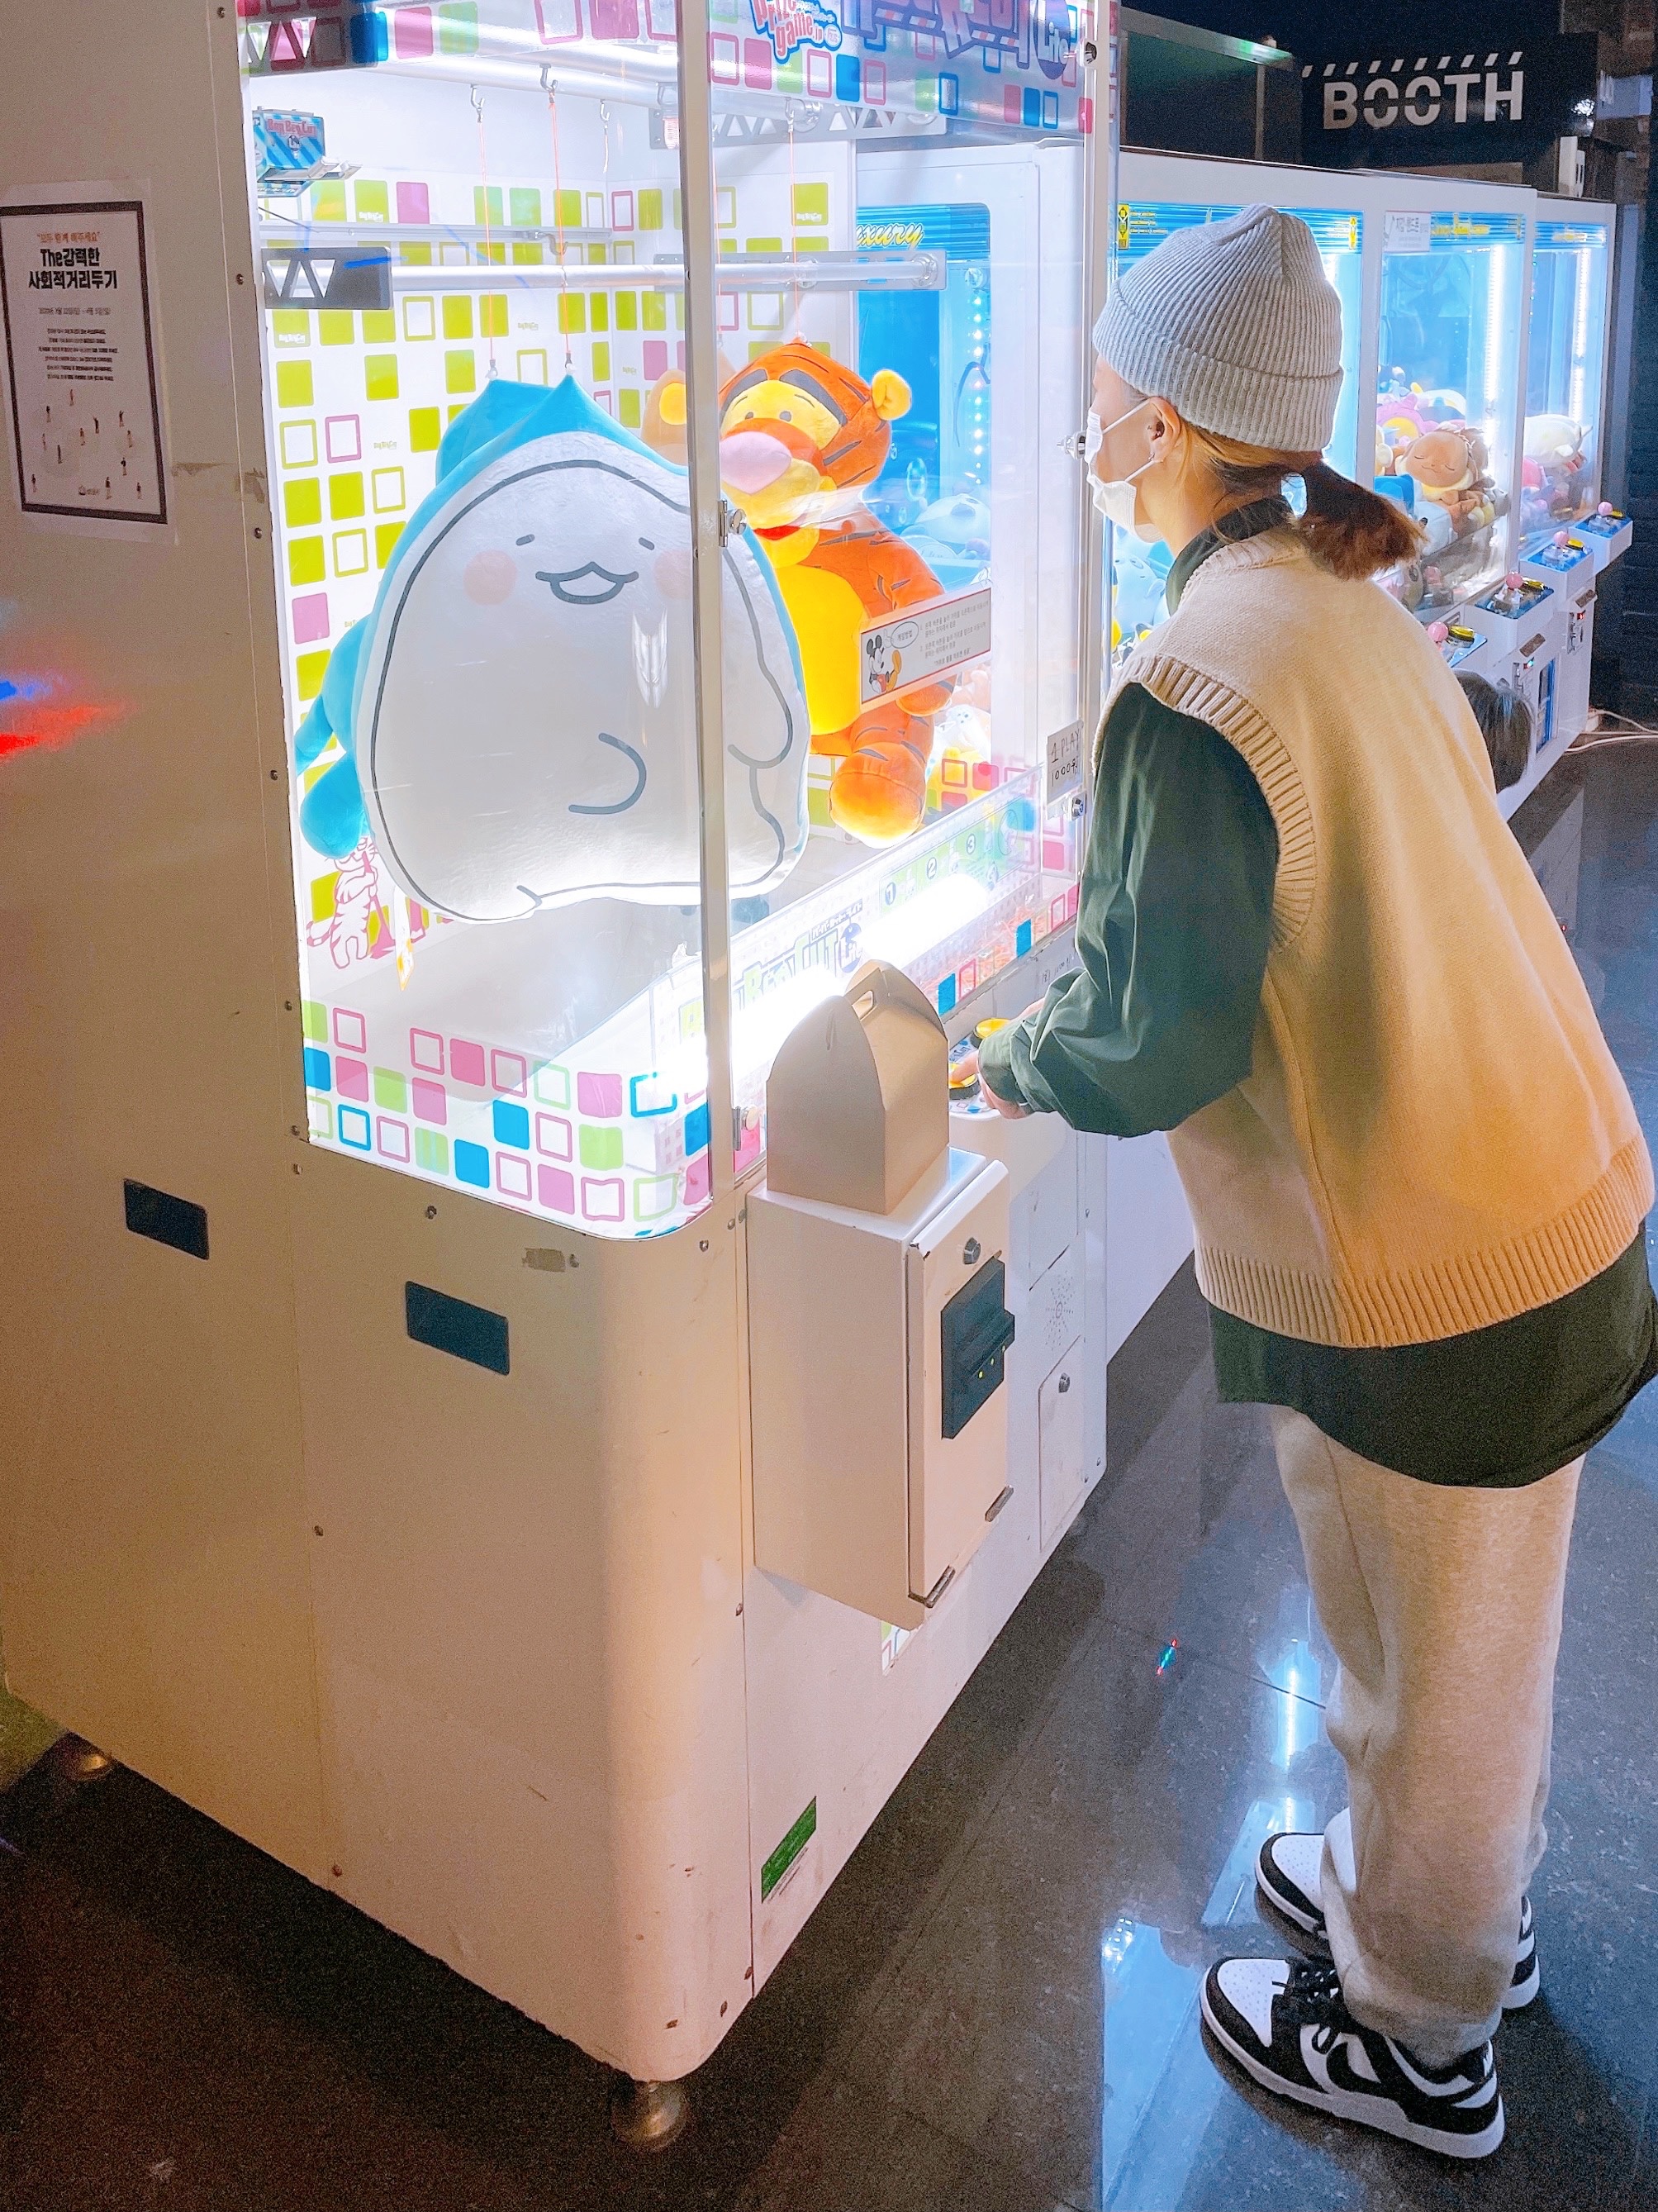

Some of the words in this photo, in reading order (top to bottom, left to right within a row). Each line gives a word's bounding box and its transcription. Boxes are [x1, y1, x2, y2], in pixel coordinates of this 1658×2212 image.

[1323, 70, 1524, 130] BOOTH
[40, 247, 100, 267] The강력한
[29, 269, 117, 289] 사회적거리두기
[1051, 742, 1059, 763] 1
[1061, 729, 1080, 758] PLAY
